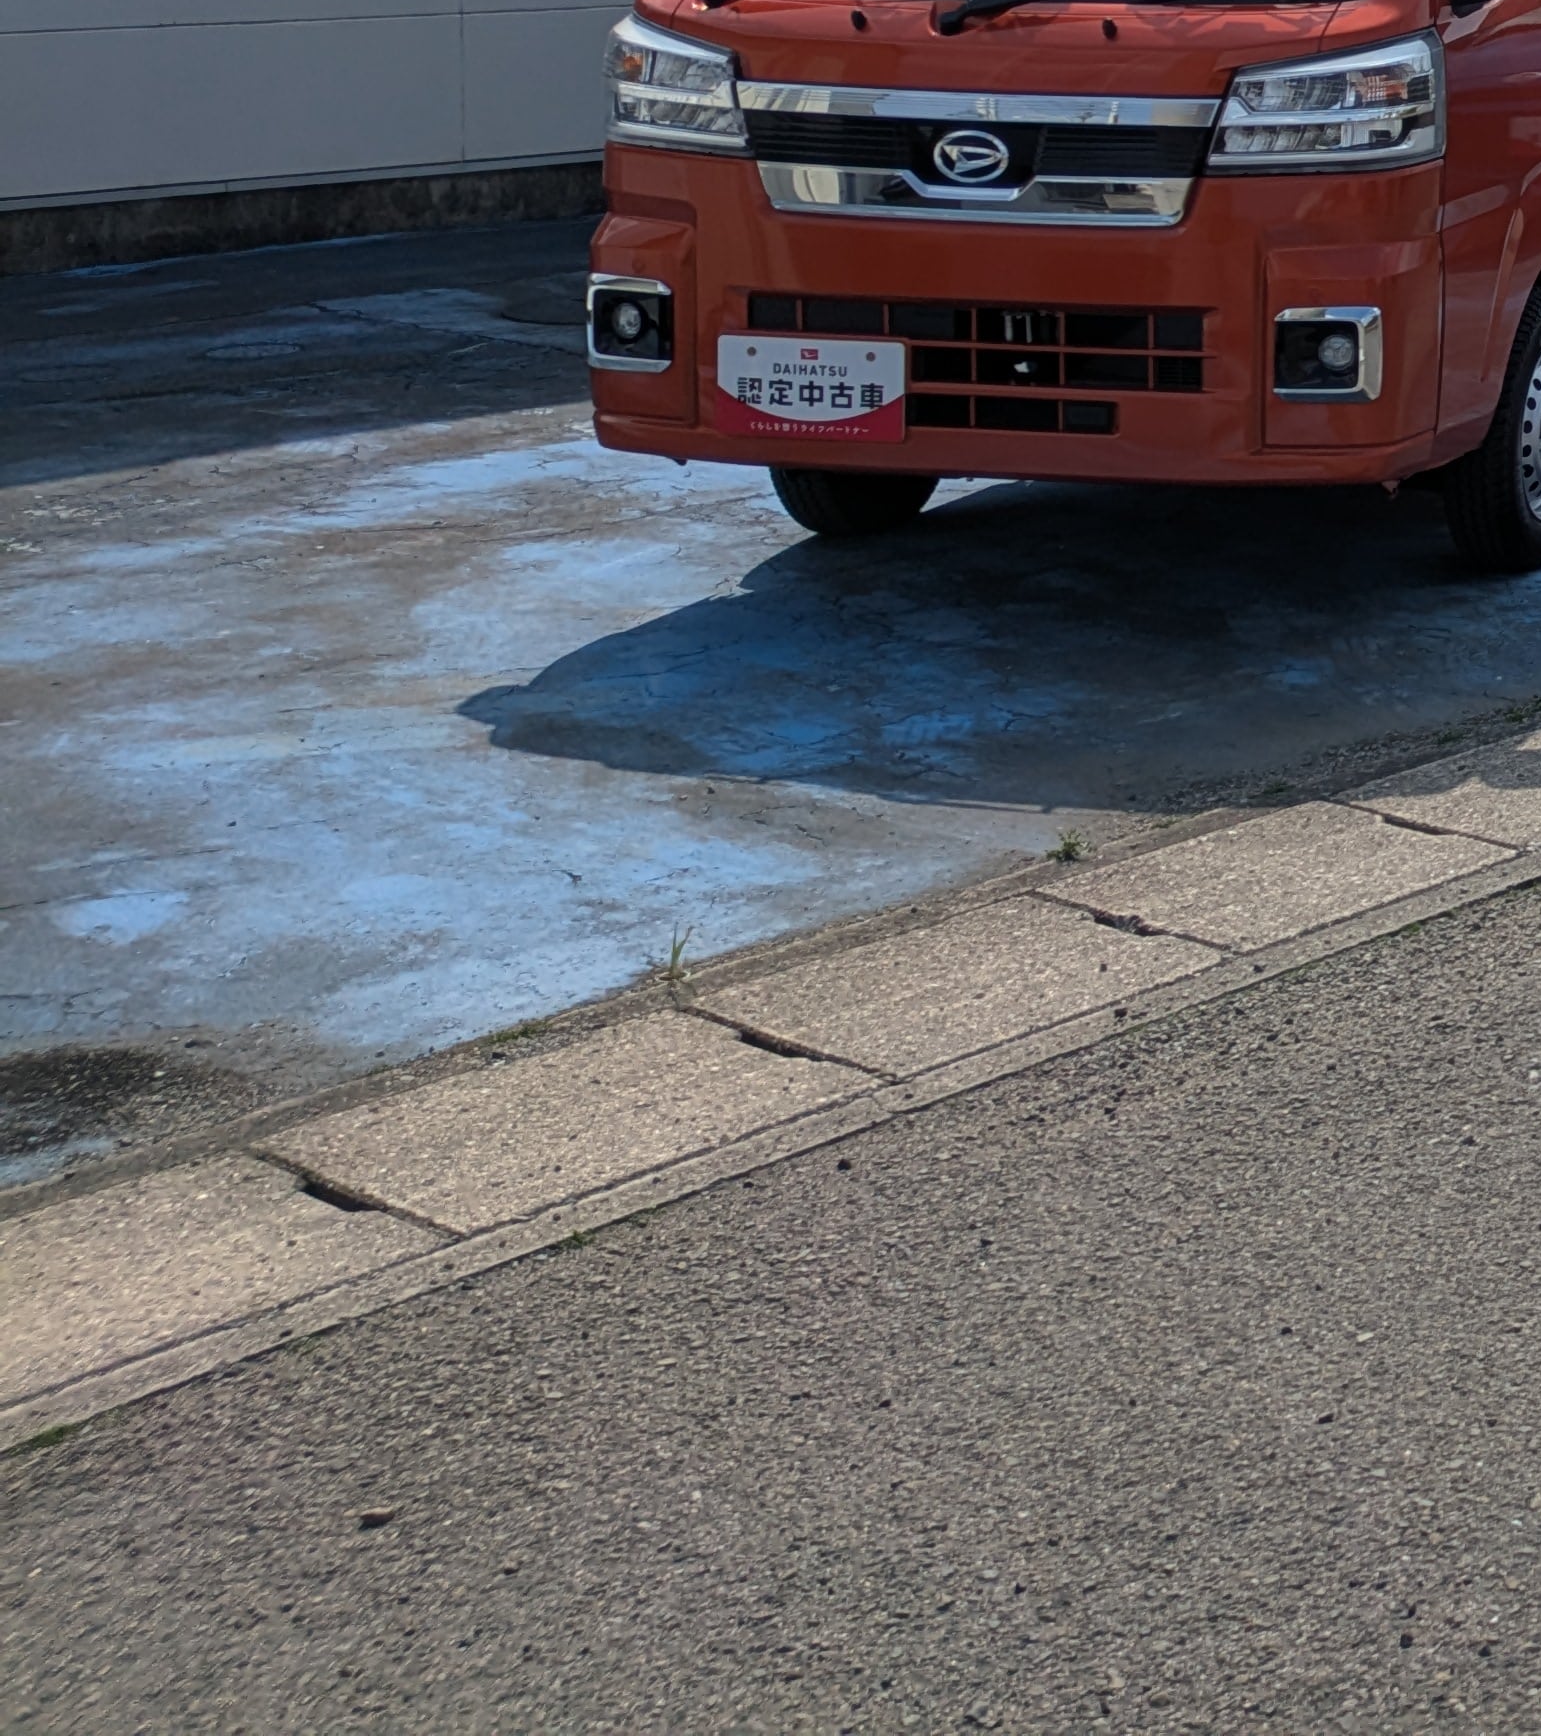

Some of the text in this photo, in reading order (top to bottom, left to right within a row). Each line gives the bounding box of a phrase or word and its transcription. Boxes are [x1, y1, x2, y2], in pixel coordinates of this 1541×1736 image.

[773, 363, 848, 377] DAIHATSU
[737, 376, 885, 409] 認定中古車
